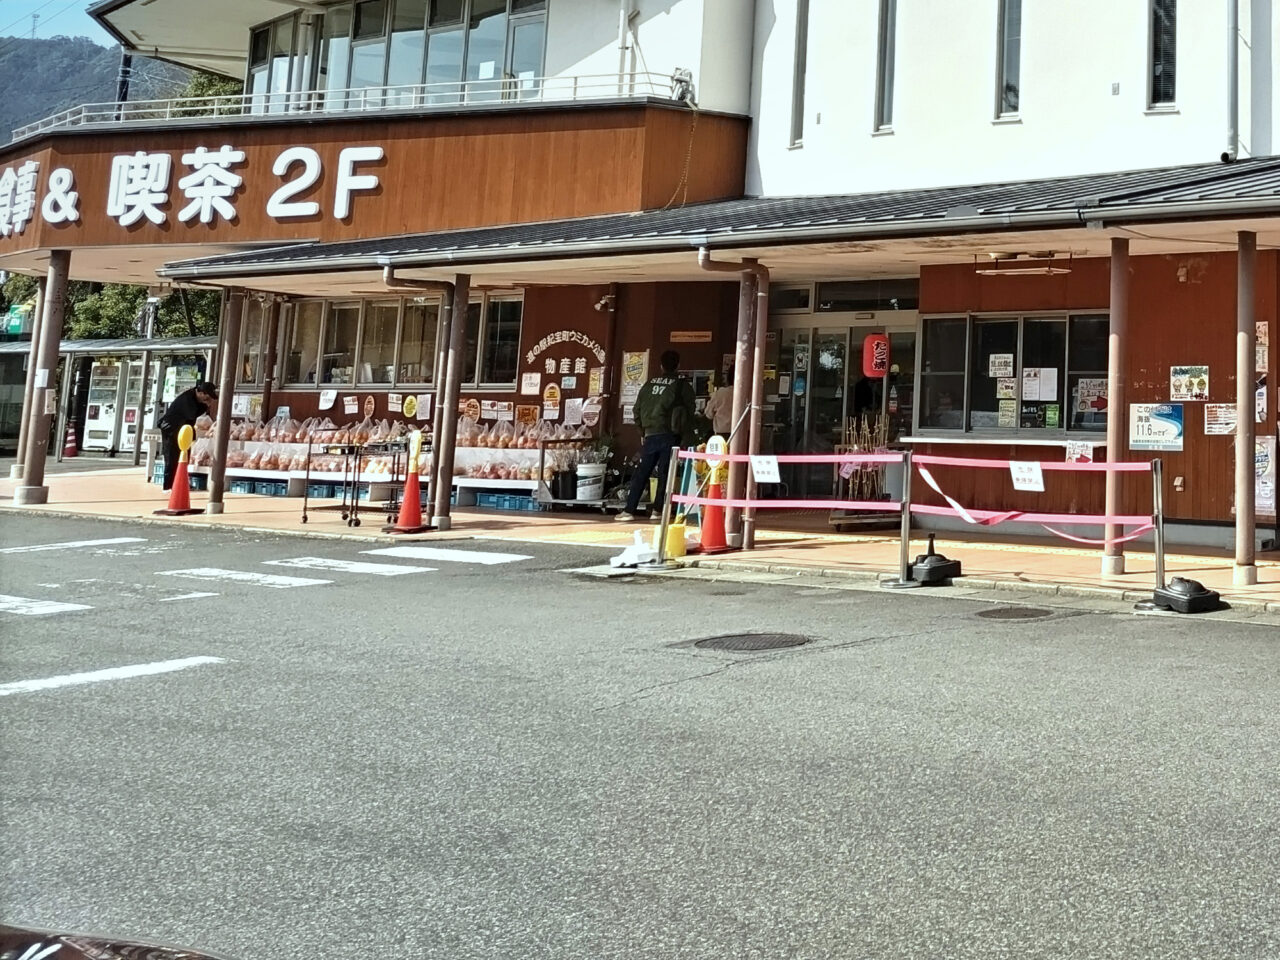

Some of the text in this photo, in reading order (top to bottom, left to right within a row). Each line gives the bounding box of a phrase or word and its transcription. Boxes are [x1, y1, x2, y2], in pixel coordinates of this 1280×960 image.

[42, 168, 80, 223] &
[107, 145, 246, 226] 喫茶
[266, 147, 384, 219] 2F
[545, 357, 588, 374] 物産館
[873, 340, 887, 371] たこ焼
[652, 385, 667, 395] 97
